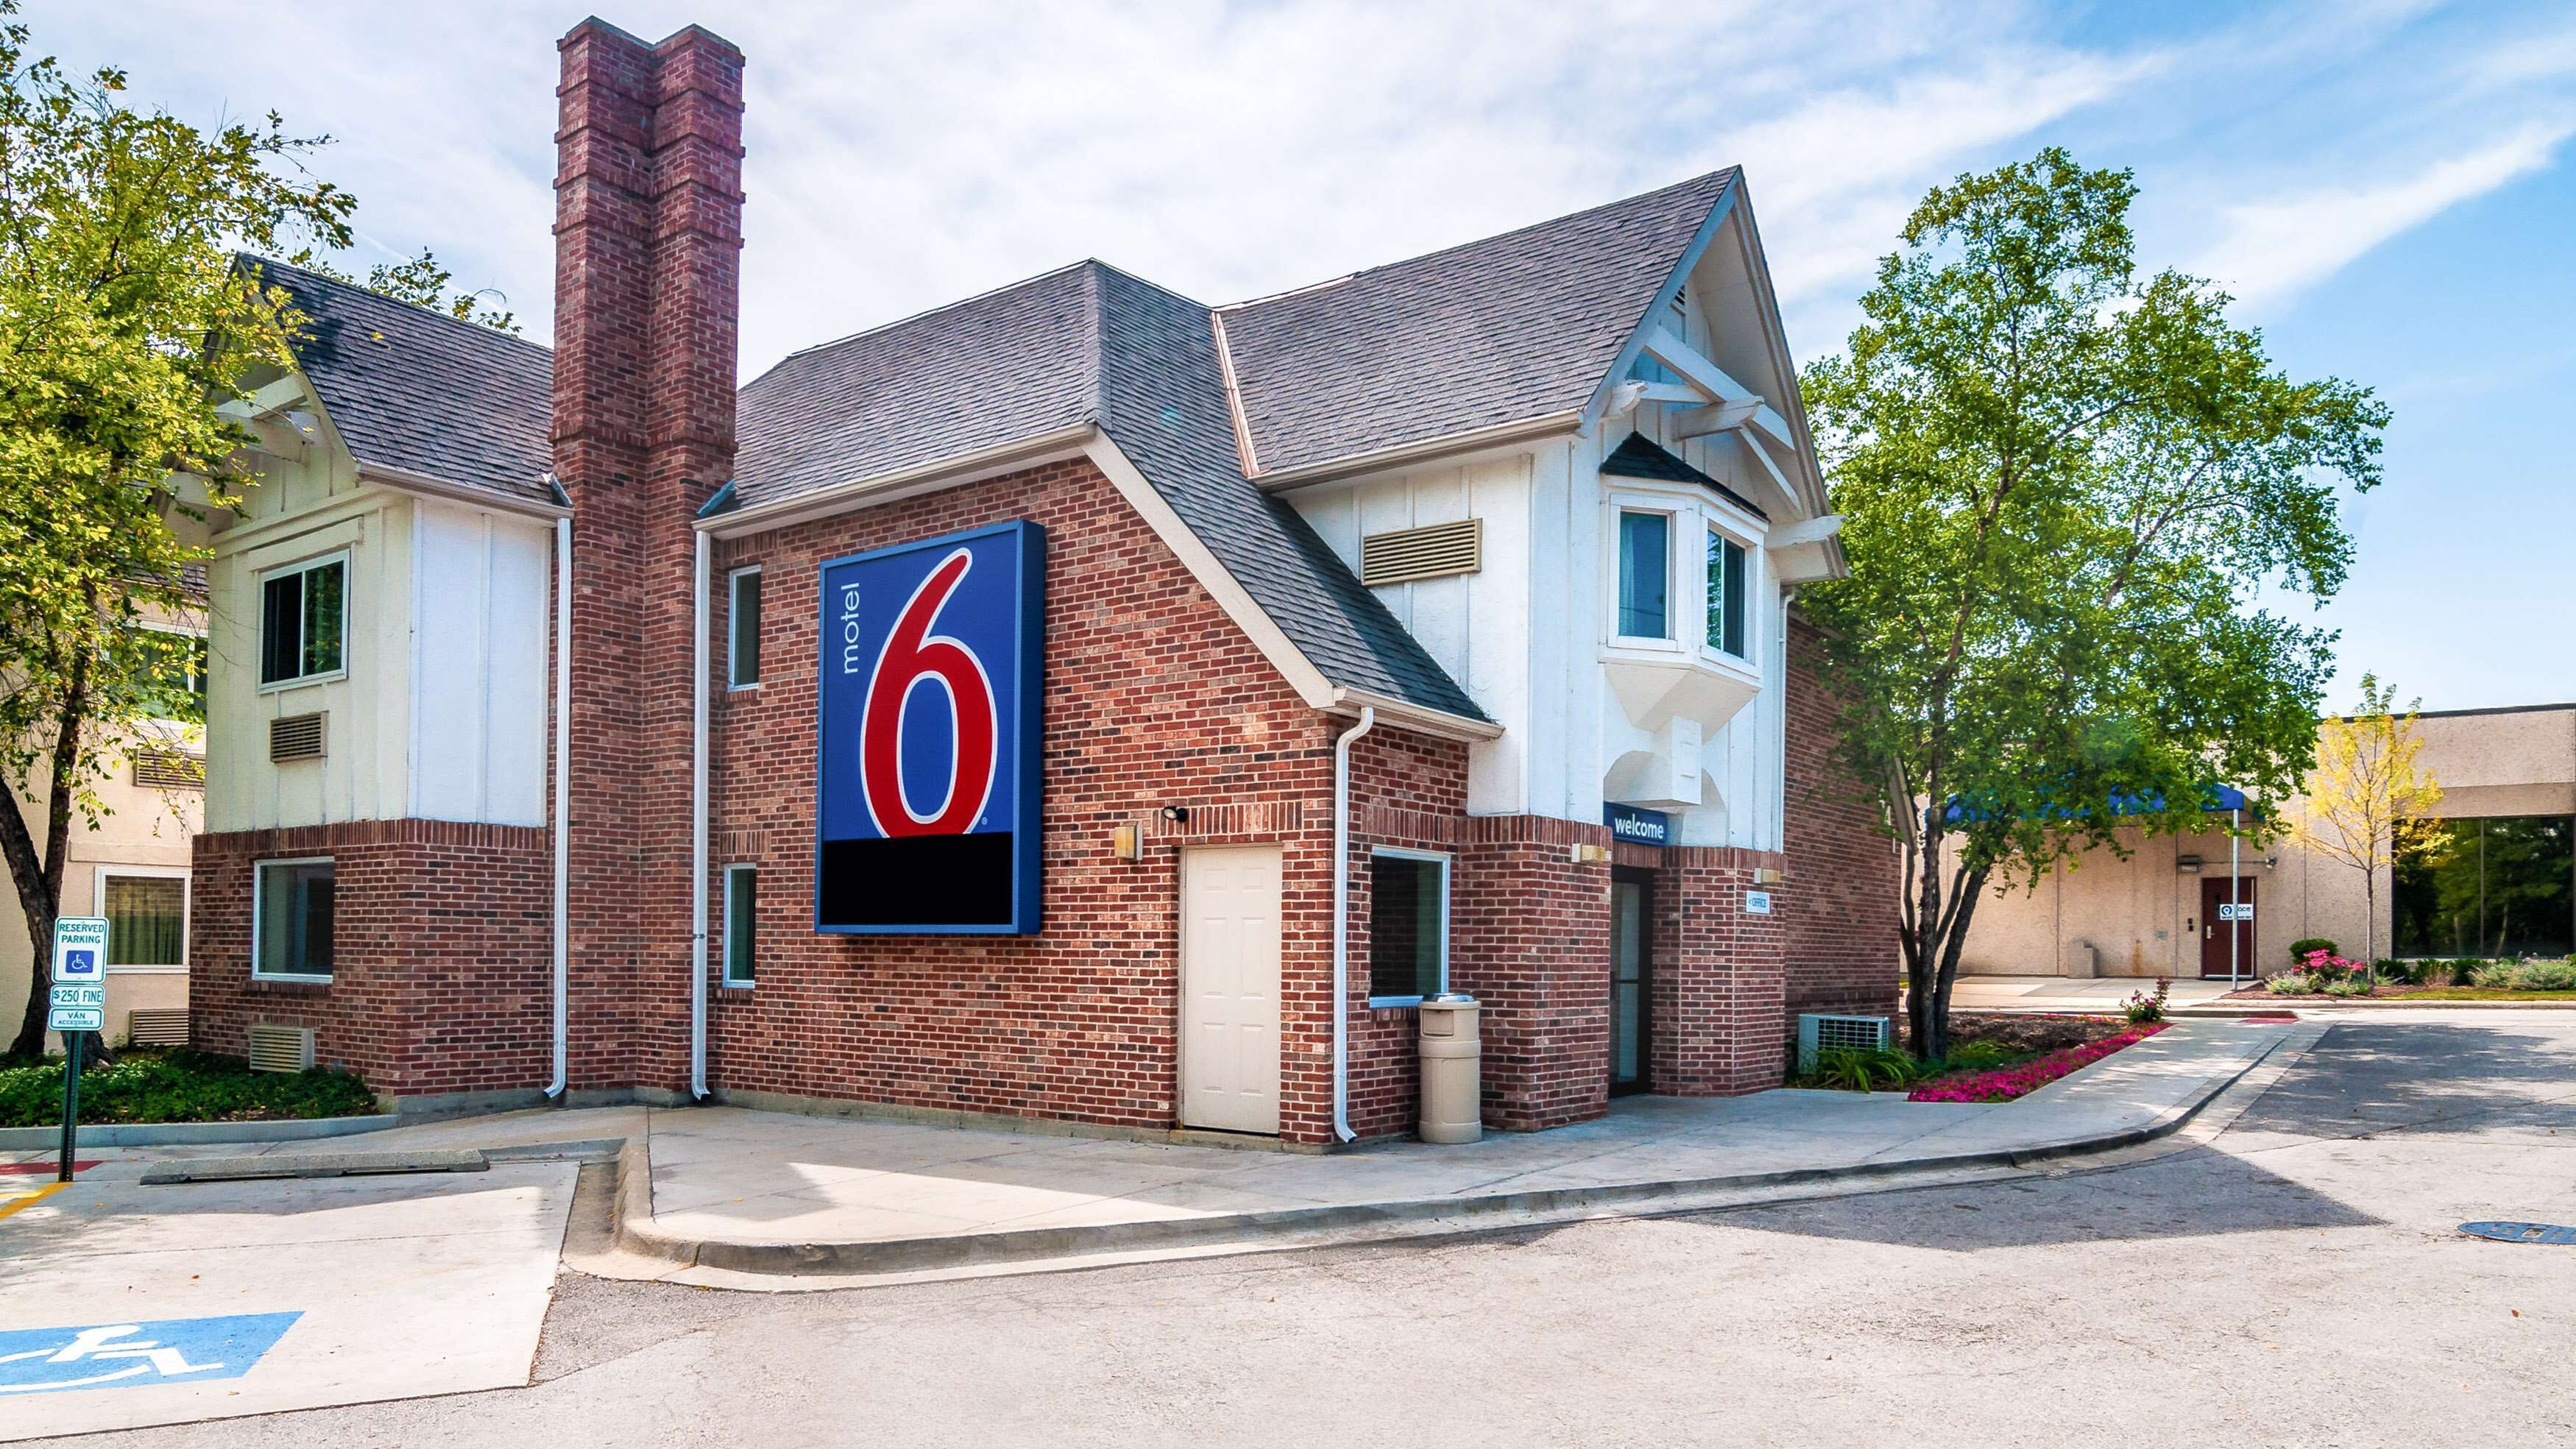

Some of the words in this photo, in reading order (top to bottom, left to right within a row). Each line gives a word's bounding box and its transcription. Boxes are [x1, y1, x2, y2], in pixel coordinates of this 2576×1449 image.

[841, 582, 859, 674] motel
[860, 547, 998, 837] 6
[1615, 813, 1663, 839] welcome
[1752, 897, 1767, 907] OFFICE
[59, 924, 105, 932] RESERVED
[61, 935, 101, 943] PARKING
[82, 991, 102, 1002] FINE
